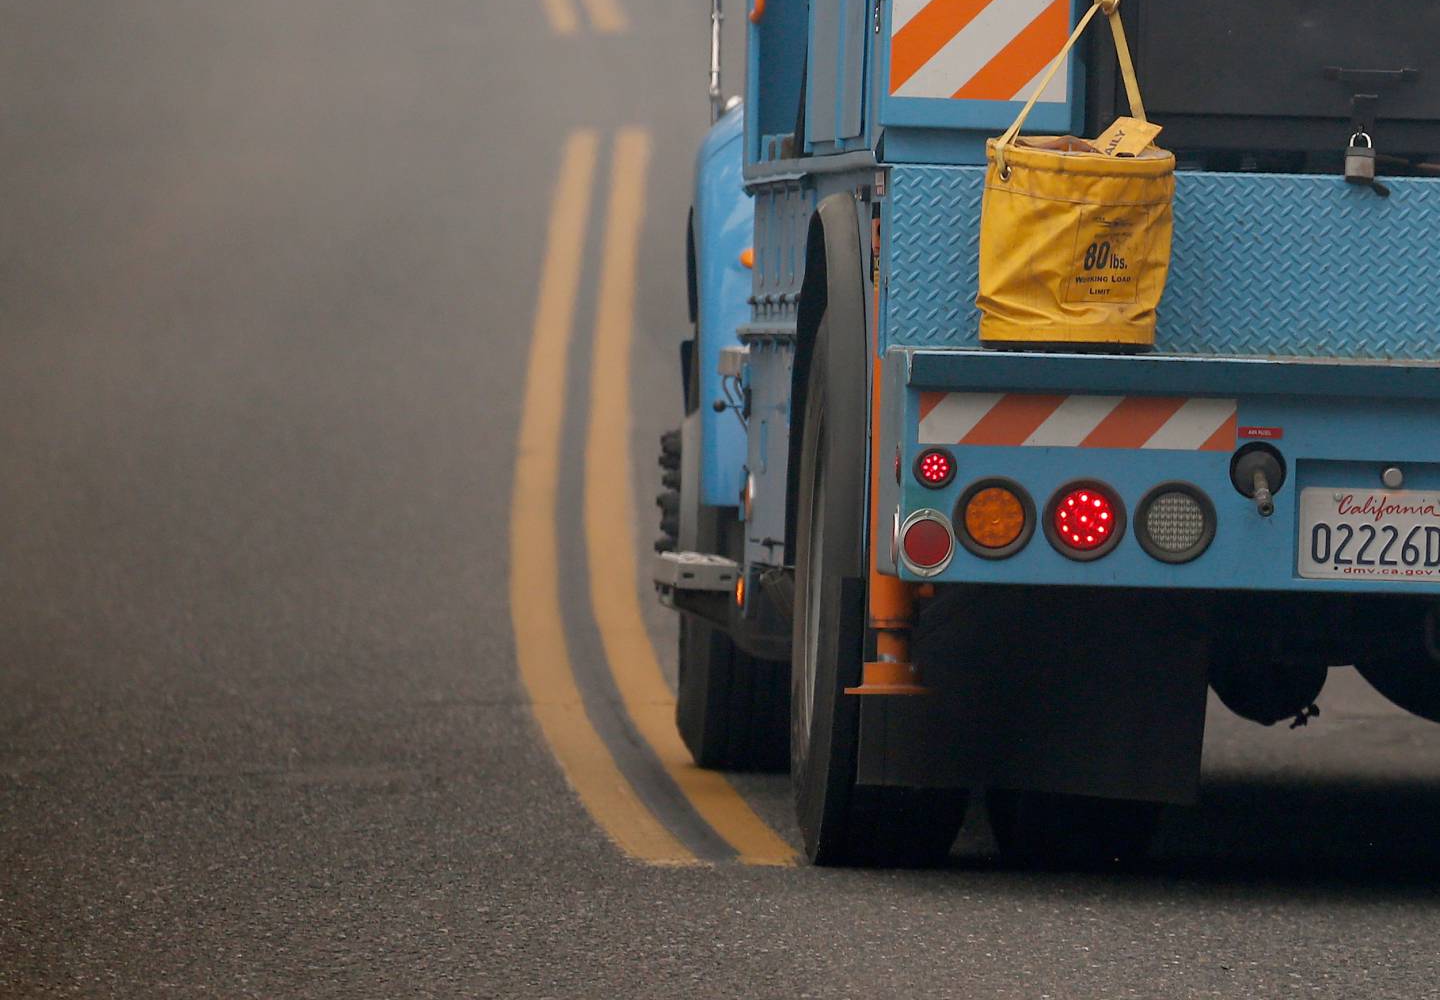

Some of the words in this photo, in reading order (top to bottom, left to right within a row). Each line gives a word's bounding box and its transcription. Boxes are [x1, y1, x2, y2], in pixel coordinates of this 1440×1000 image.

[1084, 241, 1110, 270] 80
[1109, 253, 1128, 269] lbs.
[1343, 567, 1433, 576] dmv.ca.gov
